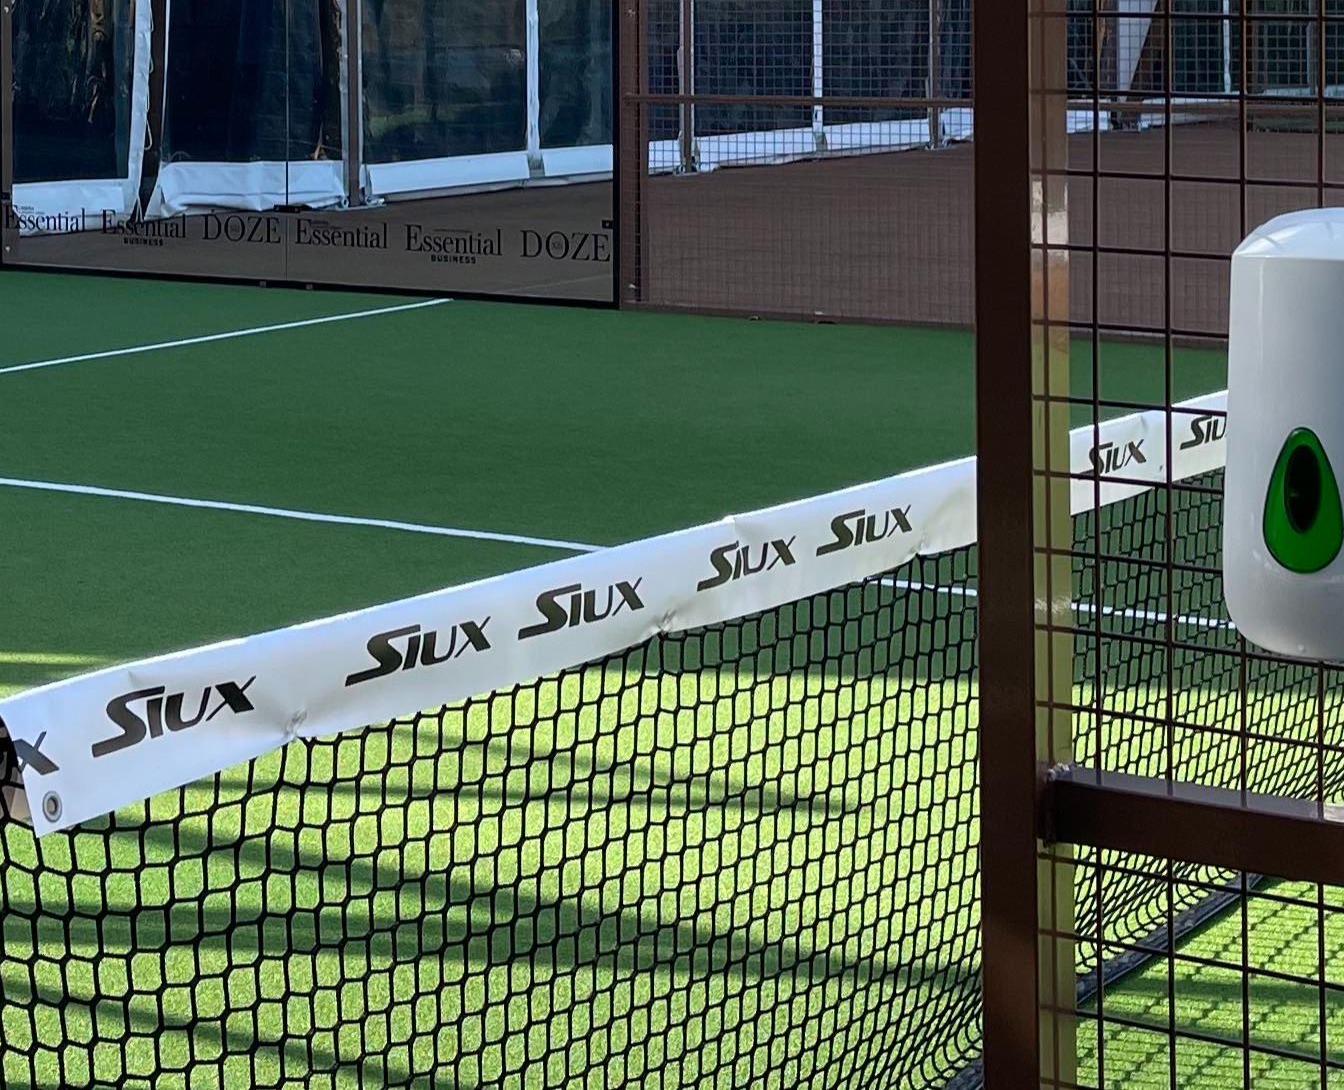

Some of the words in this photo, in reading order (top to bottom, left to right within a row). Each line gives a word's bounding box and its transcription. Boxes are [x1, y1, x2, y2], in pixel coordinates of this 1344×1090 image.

[2, 204, 86, 232] Essential
[100, 209, 187, 239] Essential
[202, 214, 281, 244] DOZE
[295, 218, 388, 249] Essential
[404, 223, 503, 257] Essential
[520, 229, 611, 262] DOZE
[430, 254, 477, 265] BUSINESS
[1180, 414, 1227, 450] SIU
